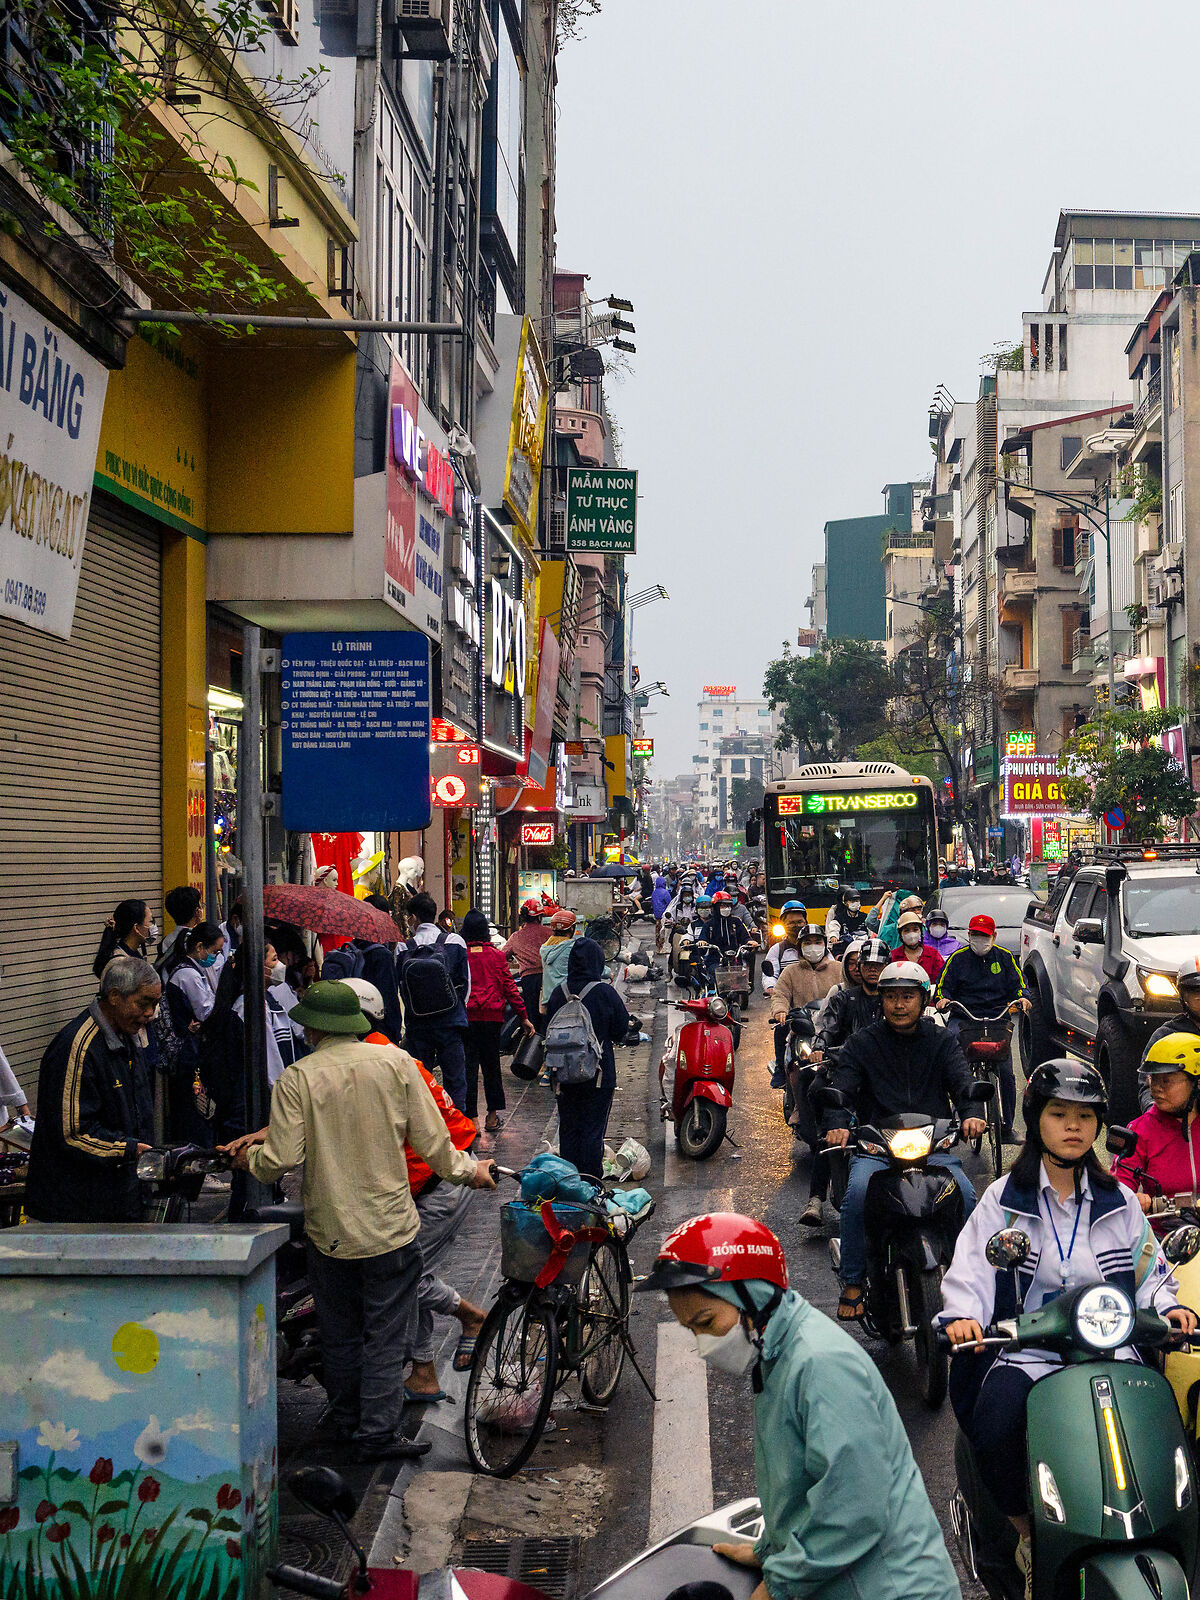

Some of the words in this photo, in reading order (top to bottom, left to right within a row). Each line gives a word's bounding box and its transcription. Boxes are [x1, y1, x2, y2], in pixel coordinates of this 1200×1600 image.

[607, 478, 633, 490] NON
[576, 494, 593, 508] TƯ
[596, 496, 628, 511] THỤC
[570, 514, 596, 532] ÁNH
[600, 515, 634, 534] VÀNG
[589, 540, 612, 549] BẠCH
[332, 640, 343, 654] LỘ
[346, 640, 372, 651] TRÌNH
[1010, 732, 1032, 743] DÁN
[1008, 744, 1036, 756] PPF
[1008, 763, 1024, 778] PHỤ
[1025, 761, 1045, 778] KIỆN
[1013, 779, 1043, 800] GIÁ
[825, 794, 918, 811] TRANSERCO
[524, 826, 551, 842] Nails
[747, 1244, 774, 1256] HẠNH
